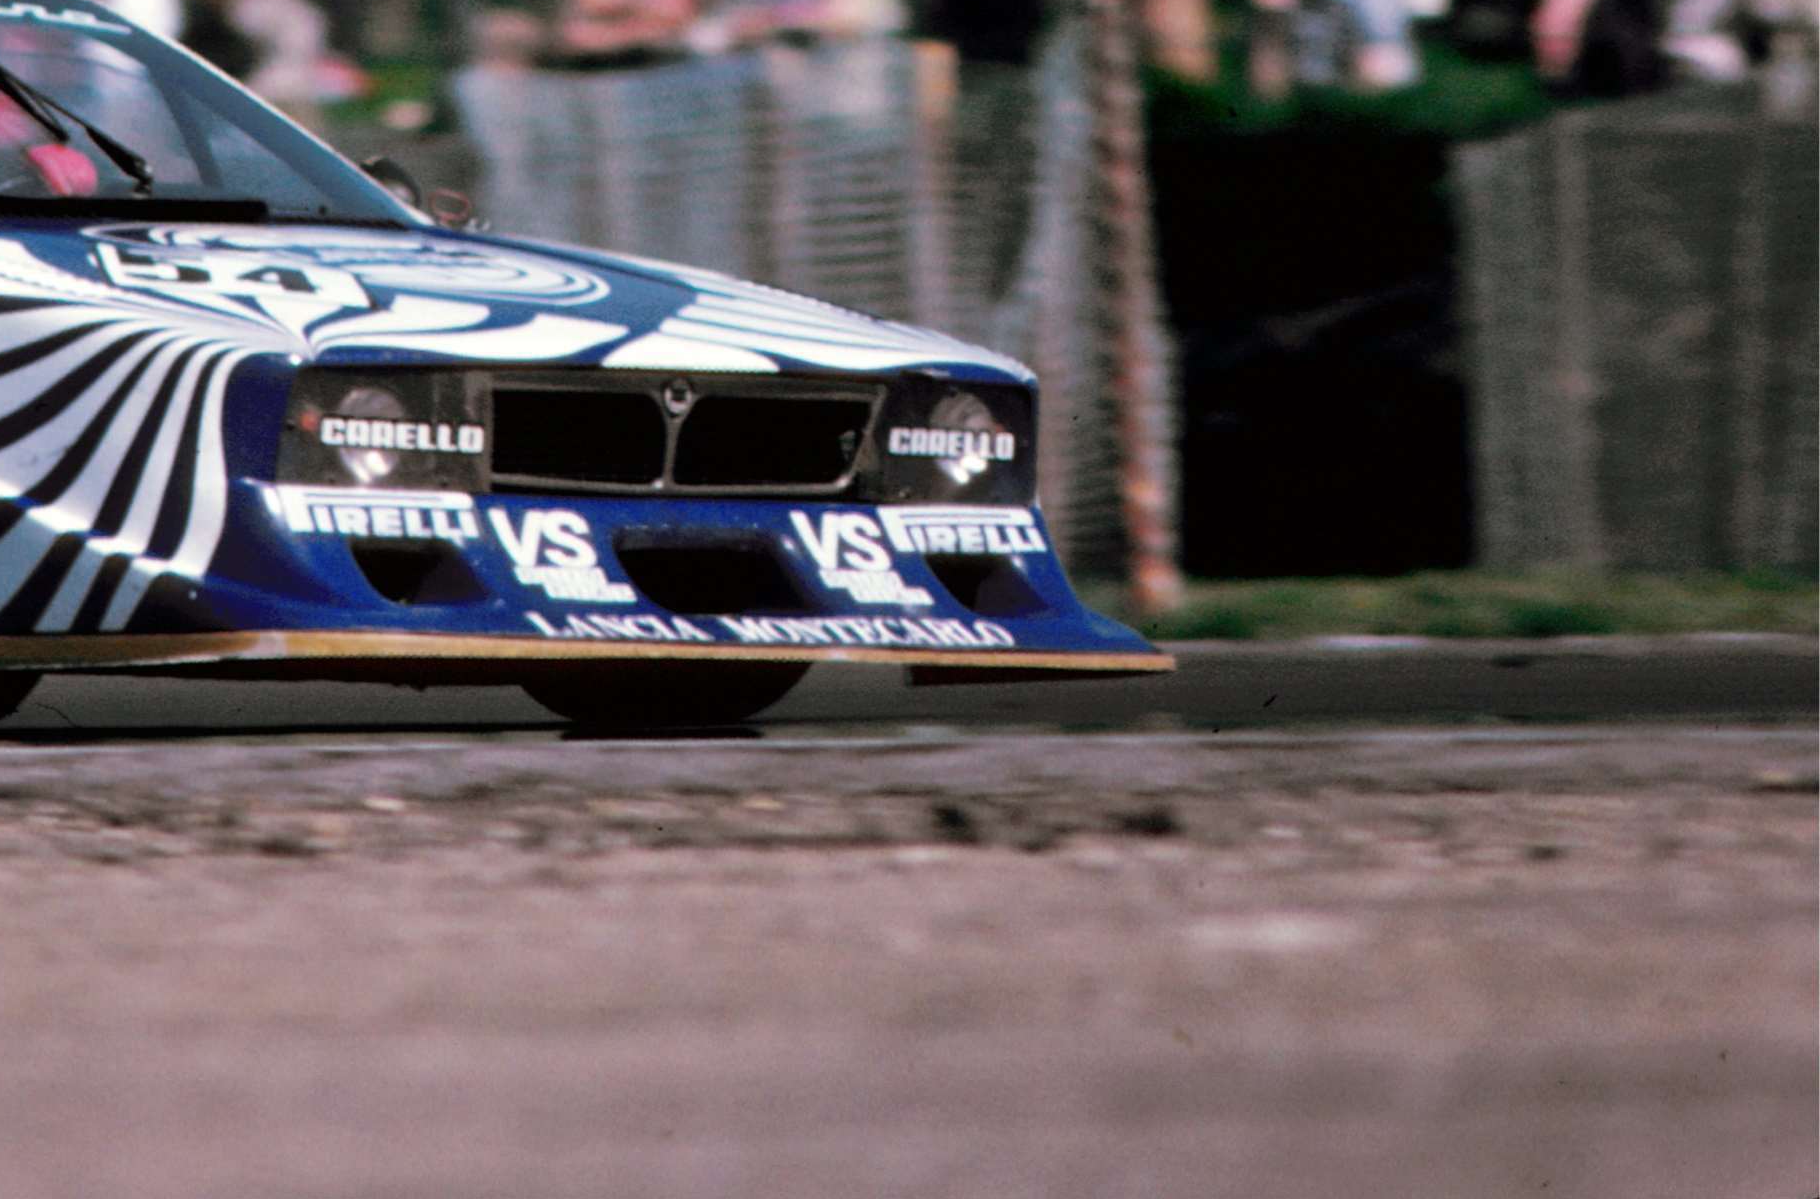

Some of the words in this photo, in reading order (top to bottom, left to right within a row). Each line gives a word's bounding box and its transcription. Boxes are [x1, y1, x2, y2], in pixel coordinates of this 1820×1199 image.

[319, 416, 485, 454] CARELLO
[888, 427, 1016, 462] CARELLO
[264, 485, 480, 539] PIRELLI
[876, 504, 1047, 554] PIRELLI
[487, 507, 597, 568] VS
[788, 509, 892, 571] VS
[523, 610, 715, 643] LANCIA
[717, 616, 1016, 648] MONTECARLO
